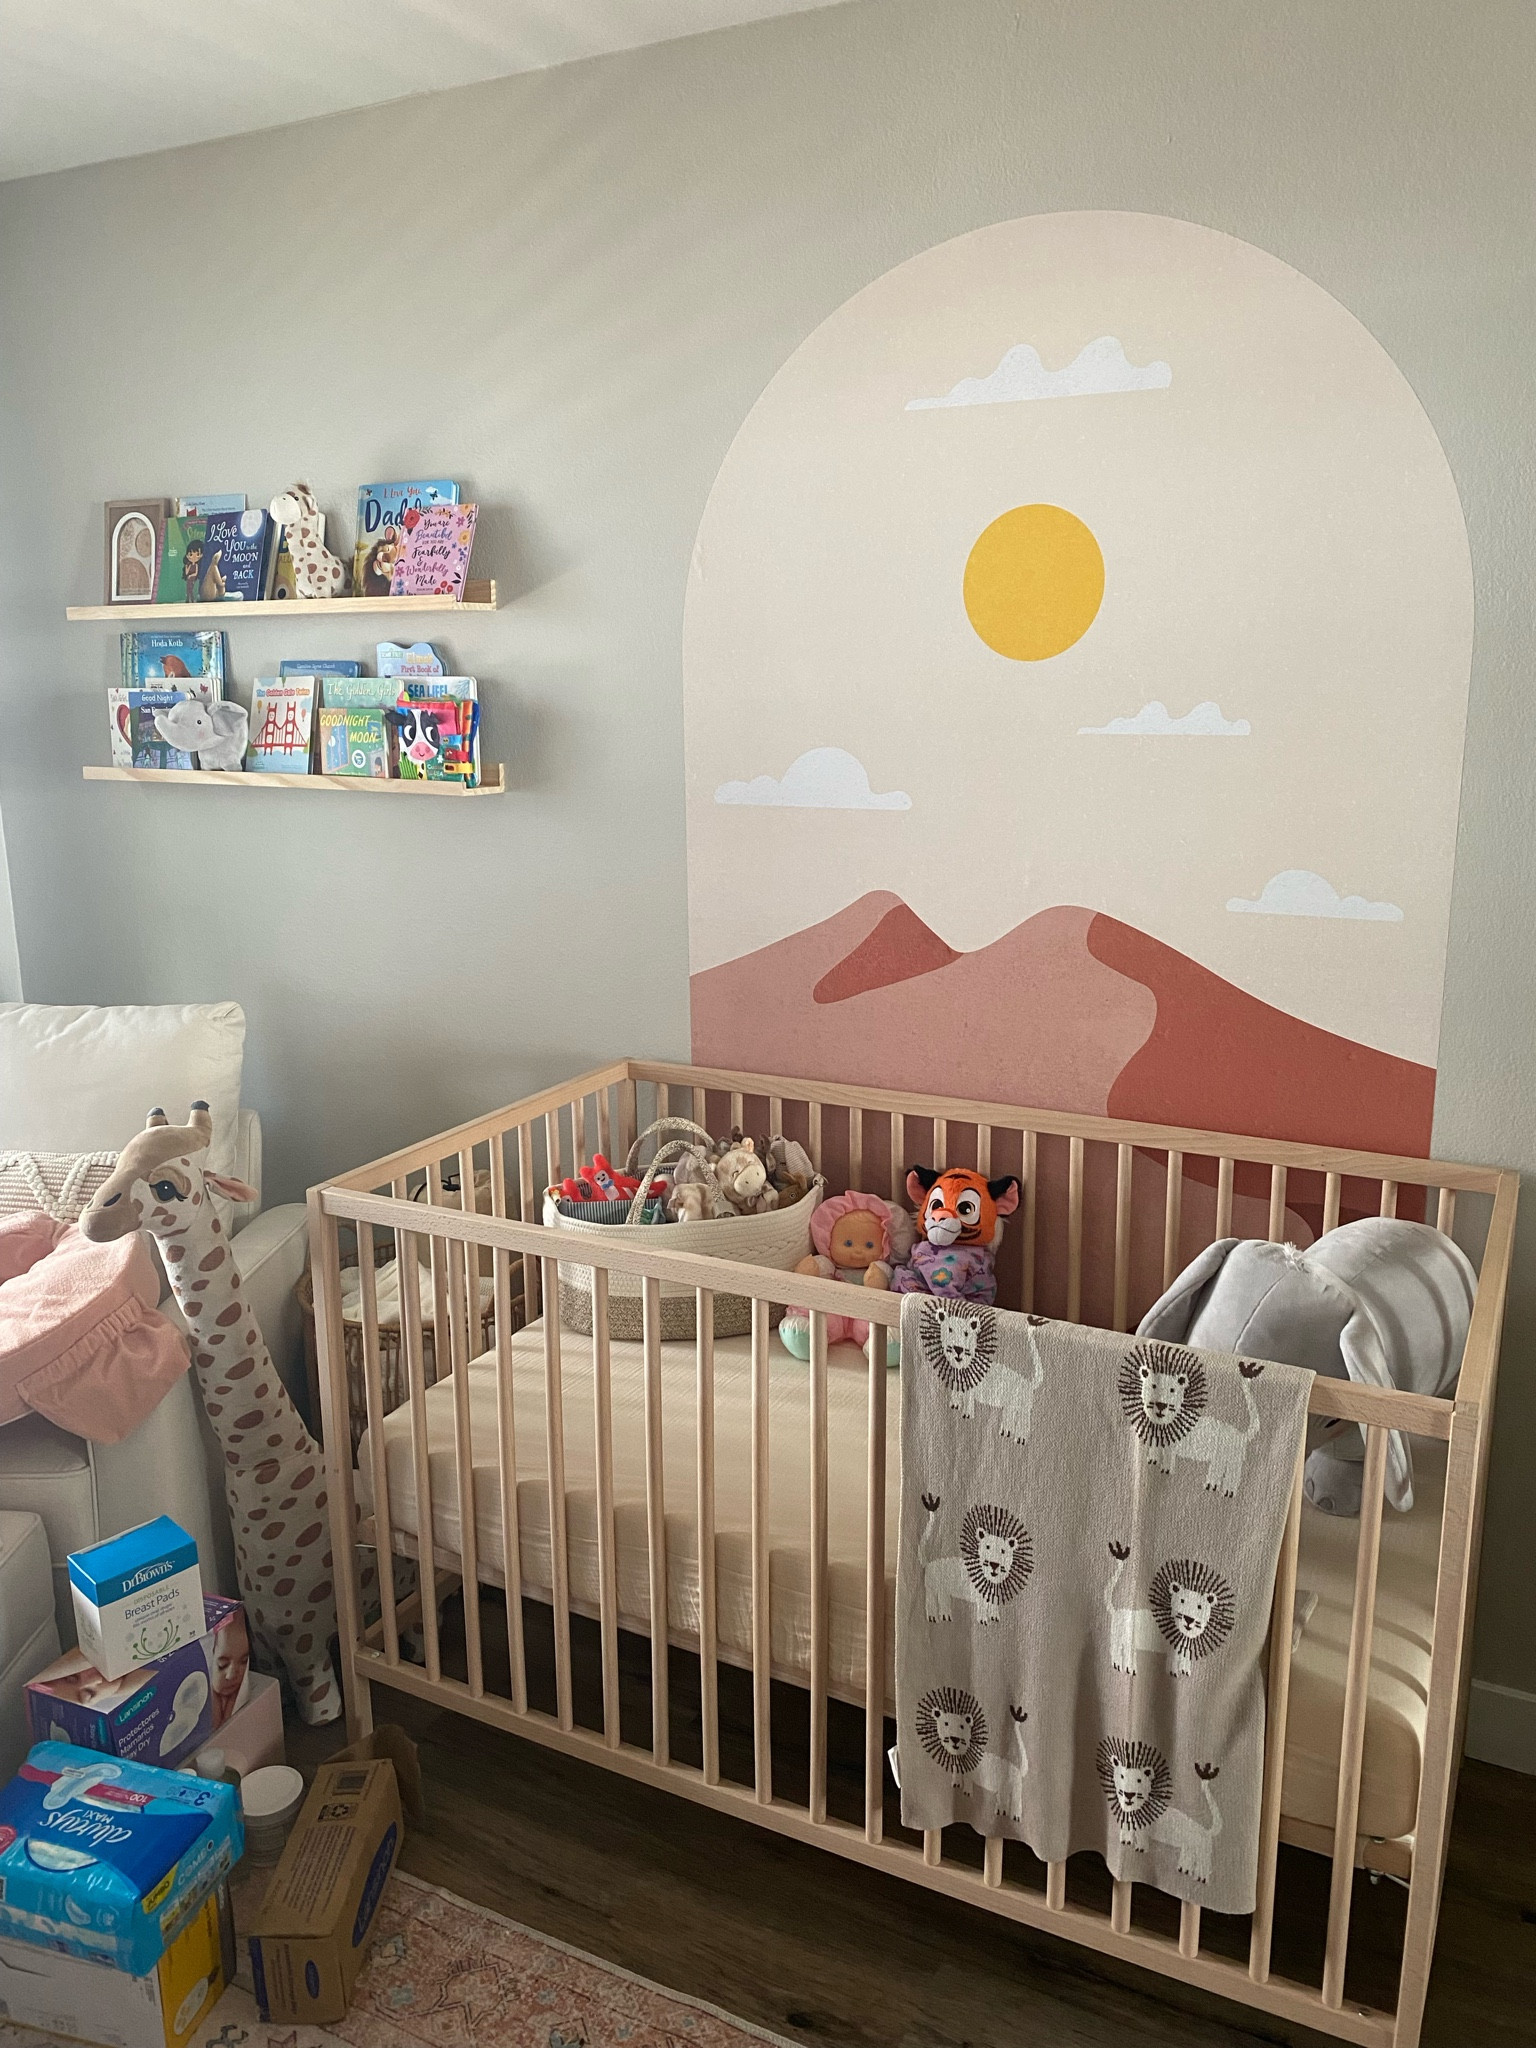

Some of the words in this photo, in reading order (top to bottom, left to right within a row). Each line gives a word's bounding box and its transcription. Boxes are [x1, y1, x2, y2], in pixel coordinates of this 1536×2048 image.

[207, 524, 215, 542] I
[213, 521, 238, 542] Love
[424, 519, 437, 530] You
[437, 520, 450, 528] are
[415, 527, 453, 543] Beautiful
[232, 551, 259, 563] MOON
[411, 545, 451, 560] Fearfully
[242, 561, 251, 569] and
[405, 561, 449, 577] Wonderfully
[233, 569, 254, 580] BACK
[415, 574, 437, 587] Made
[151, 639, 167, 648] Hoda
[169, 639, 184, 647] Kotb
[400, 665, 415, 673] First
[417, 665, 431, 673] Book
[432, 665, 440, 673] of
[327, 683, 343, 696] The
[346, 683, 374, 700] Golden
[377, 685, 396, 700] Girls
[407, 684, 426, 697] SEA
[427, 684, 448, 697] LIFE!
[141, 693, 155, 702] Good
[156, 693, 173, 703] Night
[140, 706, 150, 714] San
[320, 714, 371, 727] GOODNIGHT
[349, 731, 378, 744] MOON
[124, 1600, 155, 1620] Breast
[156, 1588, 180, 1606] Pads
[119, 1691, 154, 1723] Lansinoh
[118, 1708, 160, 1747] Protectores
[120, 1724, 155, 1757] Mamarios
[137, 1737, 151, 1751] Dry
[82, 1810, 113, 1824] MAXI
[39, 1808, 133, 1848] always
[146, 1879, 170, 1907] JUMBO
